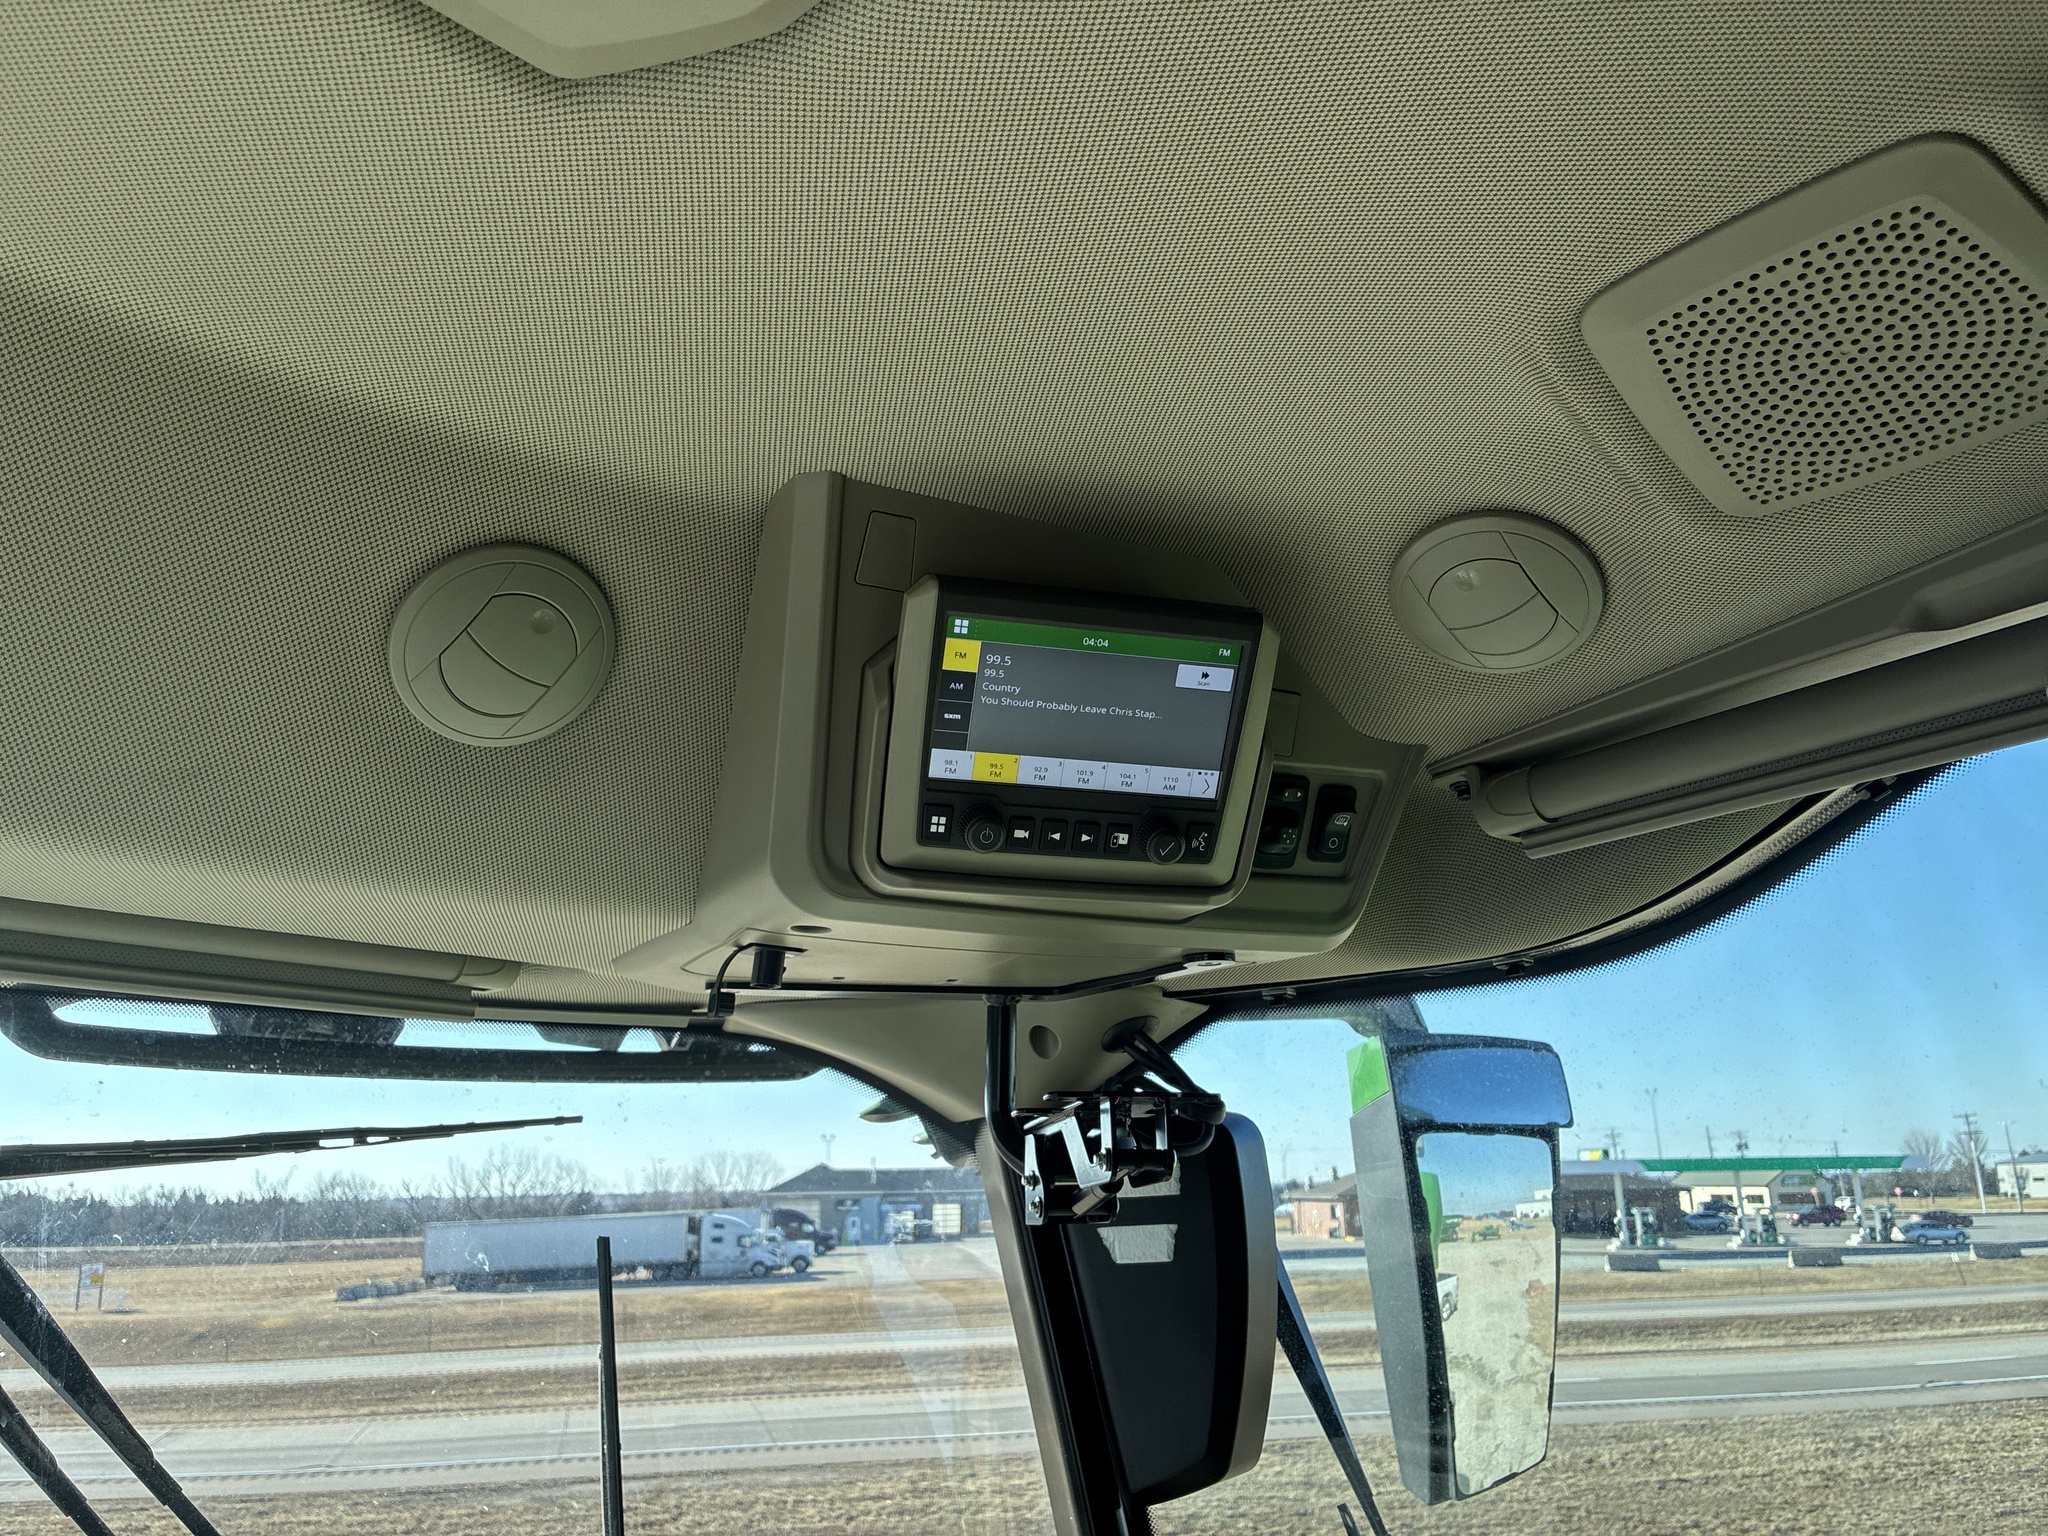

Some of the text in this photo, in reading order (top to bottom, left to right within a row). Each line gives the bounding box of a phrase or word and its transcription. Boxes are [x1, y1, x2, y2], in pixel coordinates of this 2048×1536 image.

[1083, 637, 1109, 647] 04:04
[1218, 648, 1230, 657] FM
[986, 654, 1012, 666] 99.5
[984, 668, 1005, 678] 99.5
[949, 682, 963, 690] AM
[982, 682, 1021, 695] Country
[980, 696, 1163, 720] You Should Probably Leave Chris Stap...
[944, 712, 961, 720] sxm
